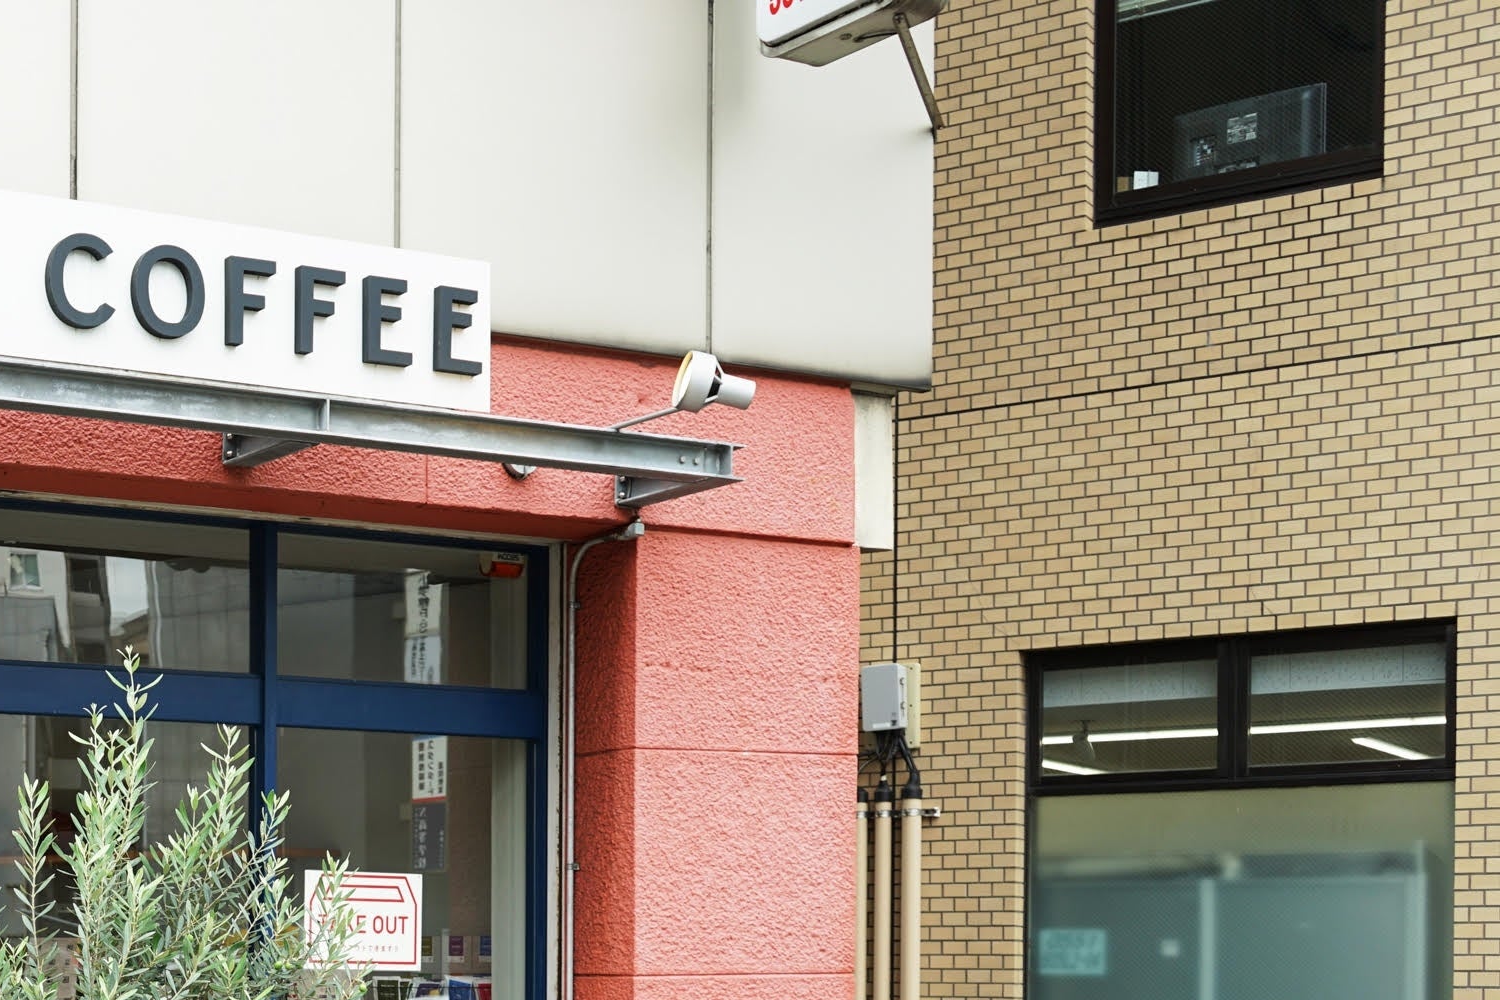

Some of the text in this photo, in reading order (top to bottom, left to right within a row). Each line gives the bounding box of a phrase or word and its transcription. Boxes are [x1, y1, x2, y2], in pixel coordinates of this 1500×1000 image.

[44, 232, 484, 376] COFFEE
[318, 914, 409, 934] TKE OUT
